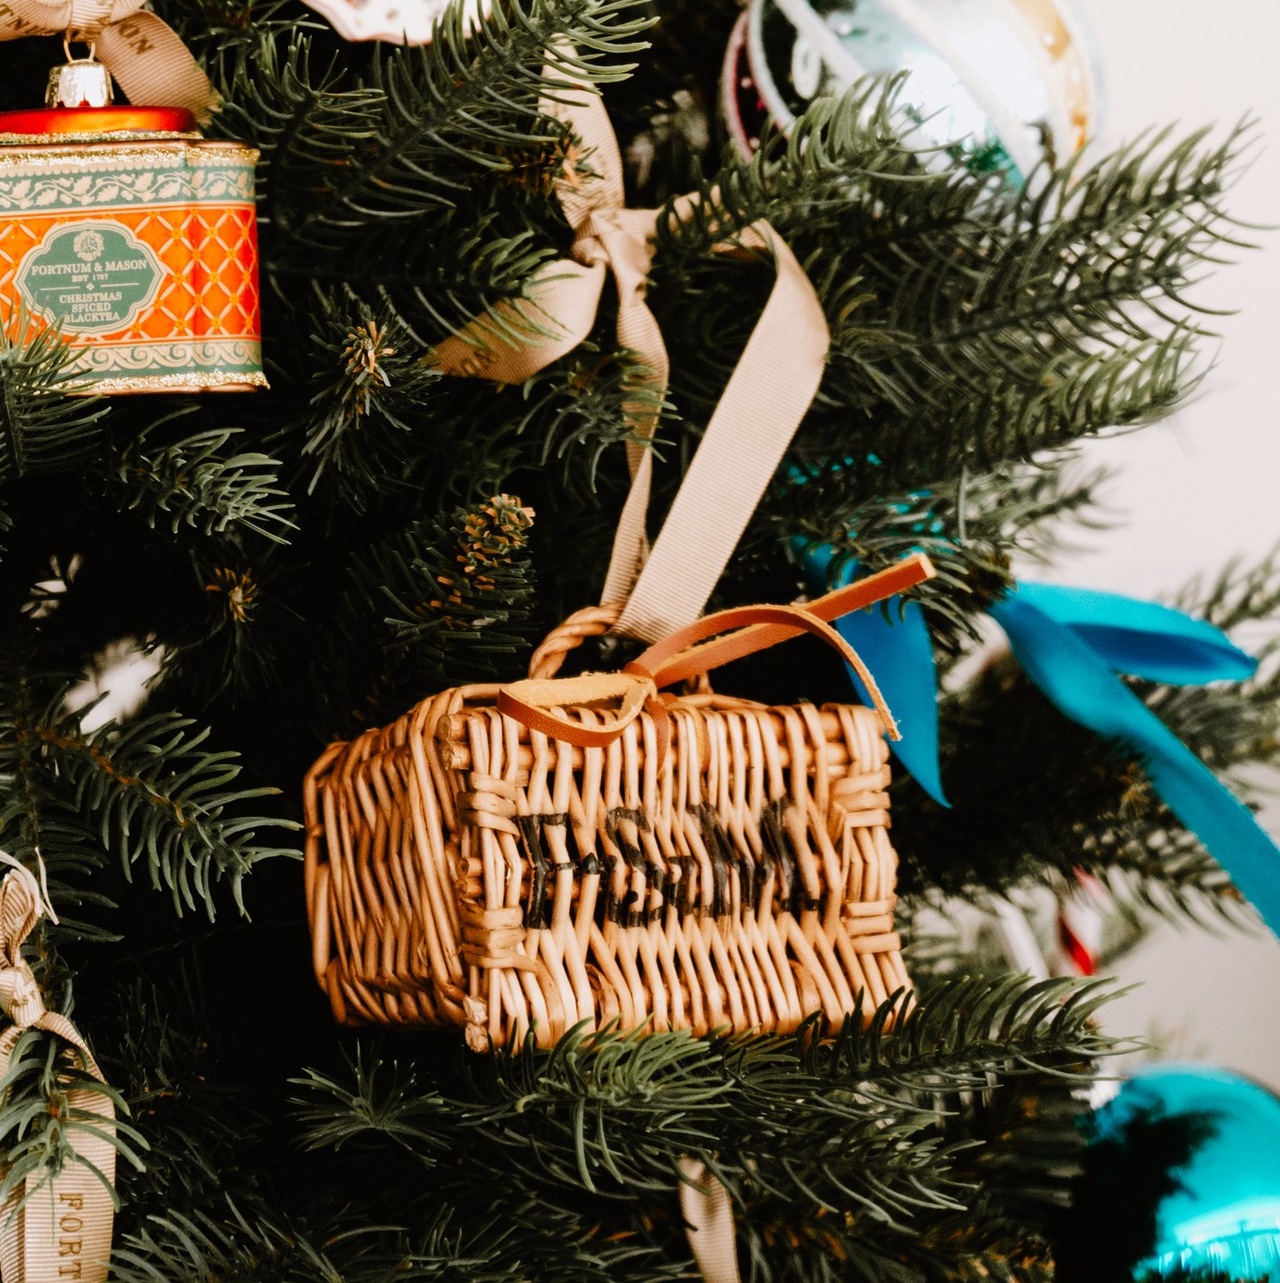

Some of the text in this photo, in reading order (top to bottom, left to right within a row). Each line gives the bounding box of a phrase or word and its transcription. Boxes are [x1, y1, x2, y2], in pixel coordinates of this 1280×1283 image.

[31, 260, 148, 275] FORTNUM & MASON
[71, 274, 89, 283] EST
[59, 292, 122, 303] CHRISTMAS
[71, 303, 111, 313] SPICED
